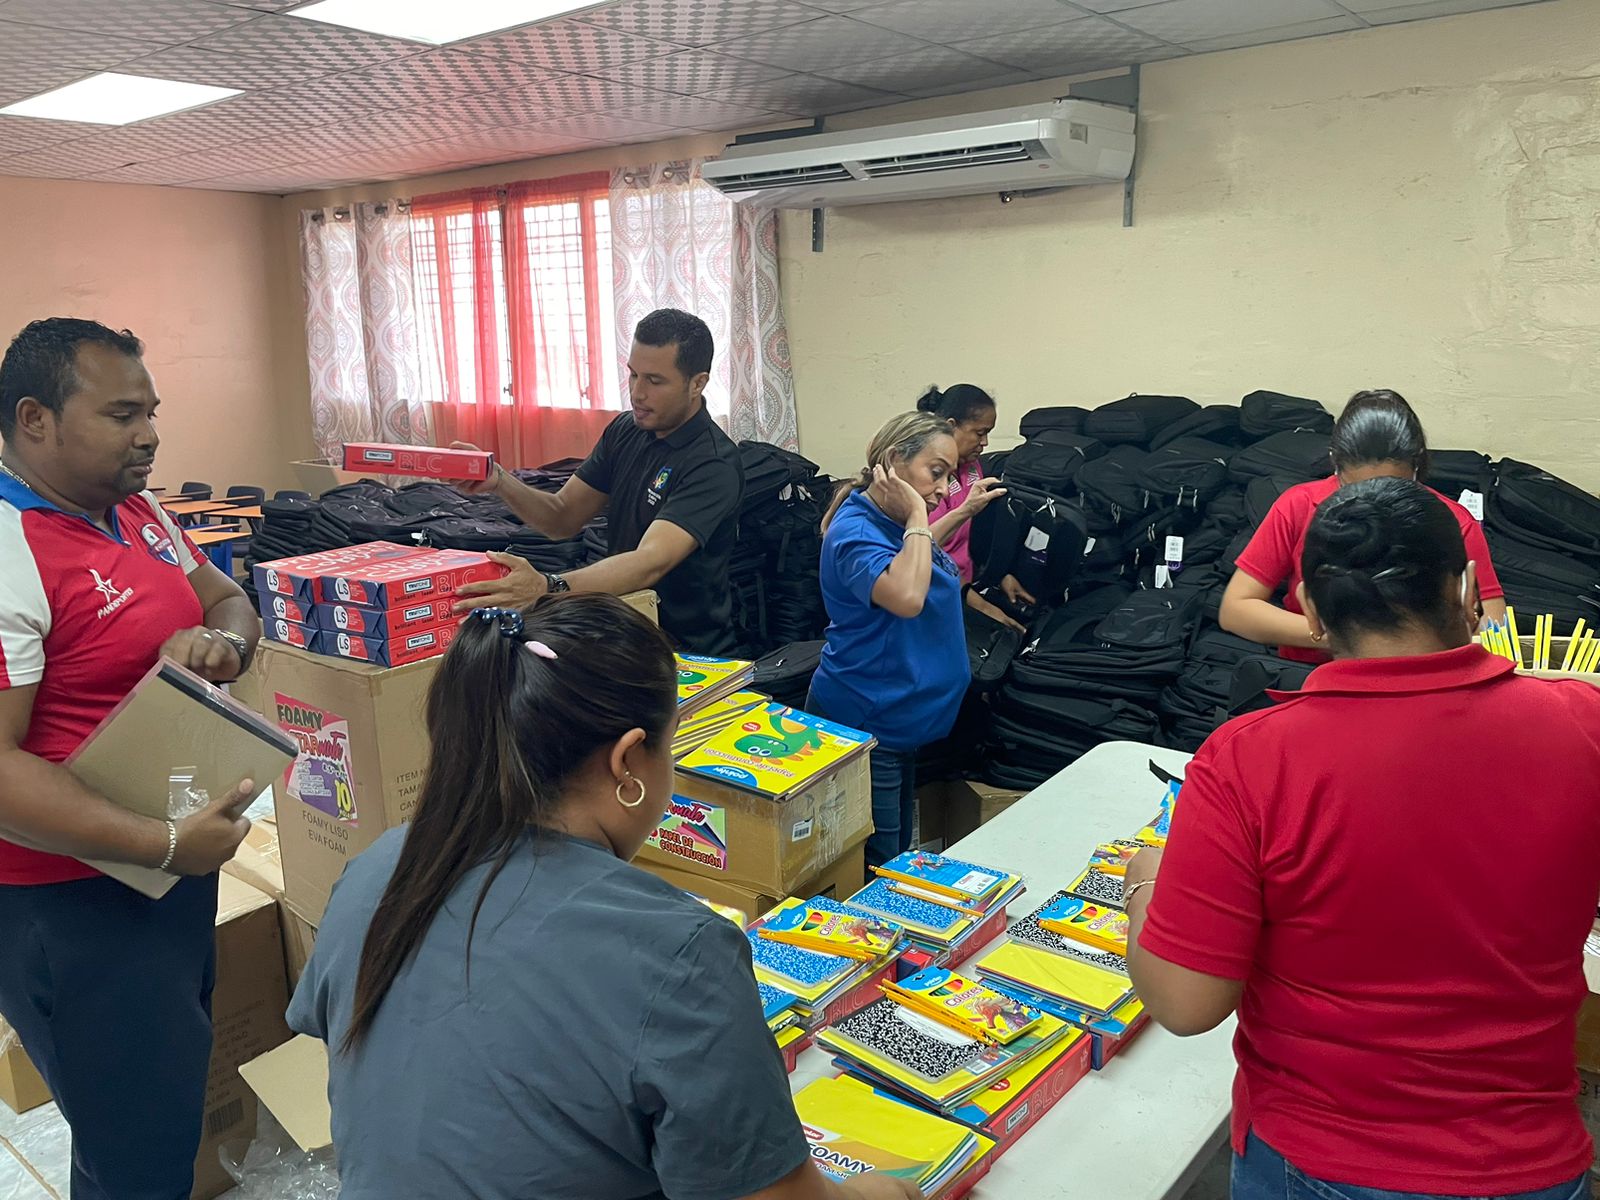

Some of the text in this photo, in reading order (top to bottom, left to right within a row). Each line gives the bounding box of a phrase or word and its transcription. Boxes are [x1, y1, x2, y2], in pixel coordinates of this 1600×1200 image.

[399, 453, 442, 473] BLC
[268, 574, 278, 586] LS
[337, 583, 349, 595] LS
[276, 601, 285, 613] LS
[336, 609, 347, 623] LS
[278, 624, 287, 636] LS
[340, 637, 349, 650] LS
[277, 704, 323, 731] FOAMY
[396, 770, 418, 783] ITEM
[713, 766, 749, 779] pointer
[335, 780, 352, 812] 10
[303, 810, 328, 830] FOAMY
[330, 823, 348, 840] LISO
[660, 828, 682, 844] PAPEL
[682, 836, 694, 848] DE
[660, 839, 722, 868] CONSTRUCCIÓN
[945, 986, 983, 1006] Colores
[1031, 1068, 1064, 1119] BLC
